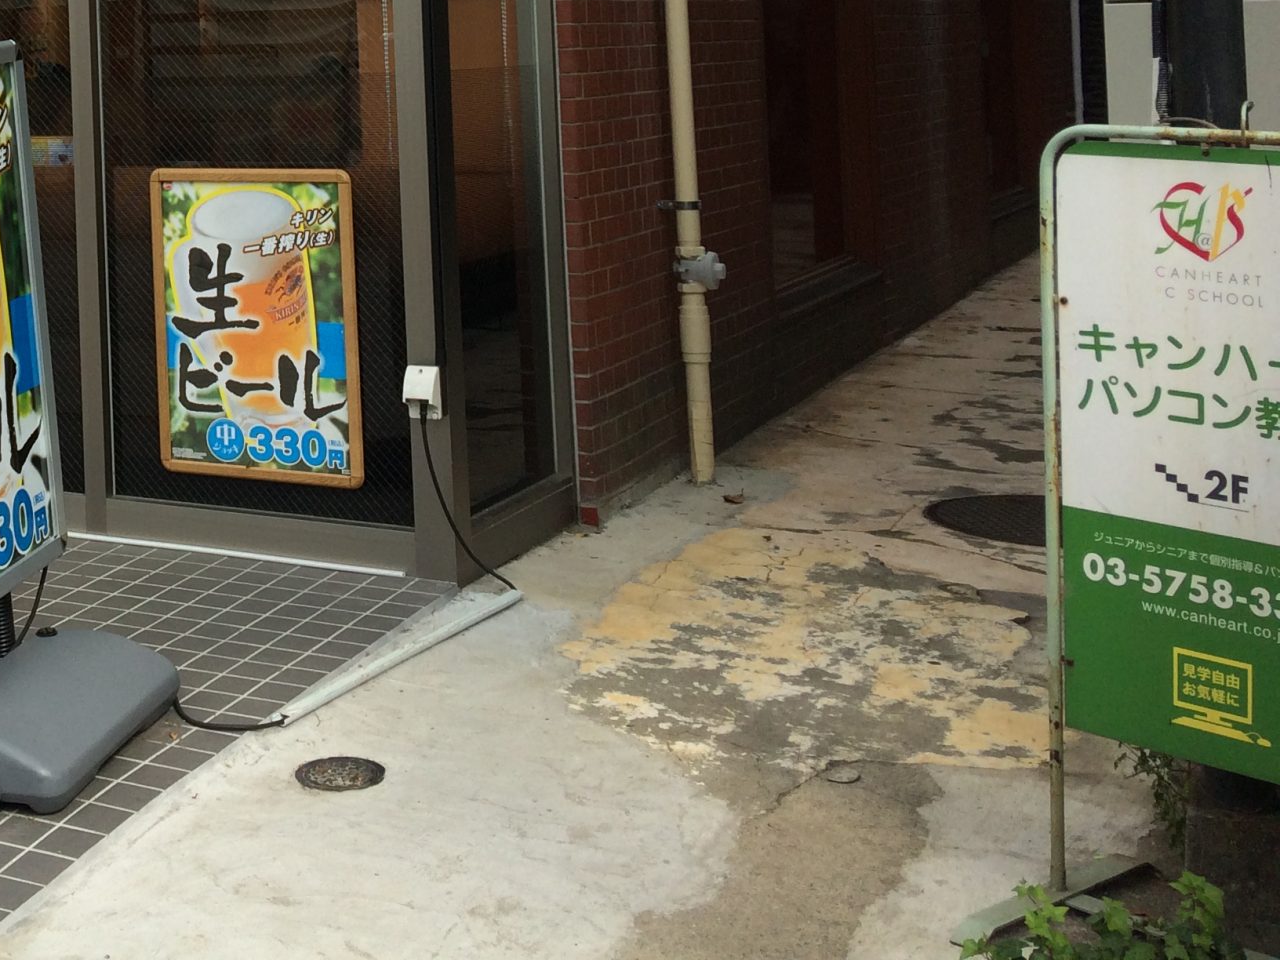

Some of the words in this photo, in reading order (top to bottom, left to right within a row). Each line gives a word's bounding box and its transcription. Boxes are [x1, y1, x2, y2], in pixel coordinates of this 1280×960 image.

[290, 208, 334, 229] キリン
[243, 230, 334, 257] 一番搾り(生)
[1154, 265, 1263, 288] CANHEART
[171, 243, 260, 339] 生
[1187, 288, 1264, 309] SCHOOL
[179, 343, 348, 422] ビール
[216, 424, 236, 446] 中
[247, 424, 347, 470] 330円
[1204, 470, 1249, 504] 2F
[1182, 662, 1241, 690] 見学自由
[1182, 681, 1240, 708] お気軽に
